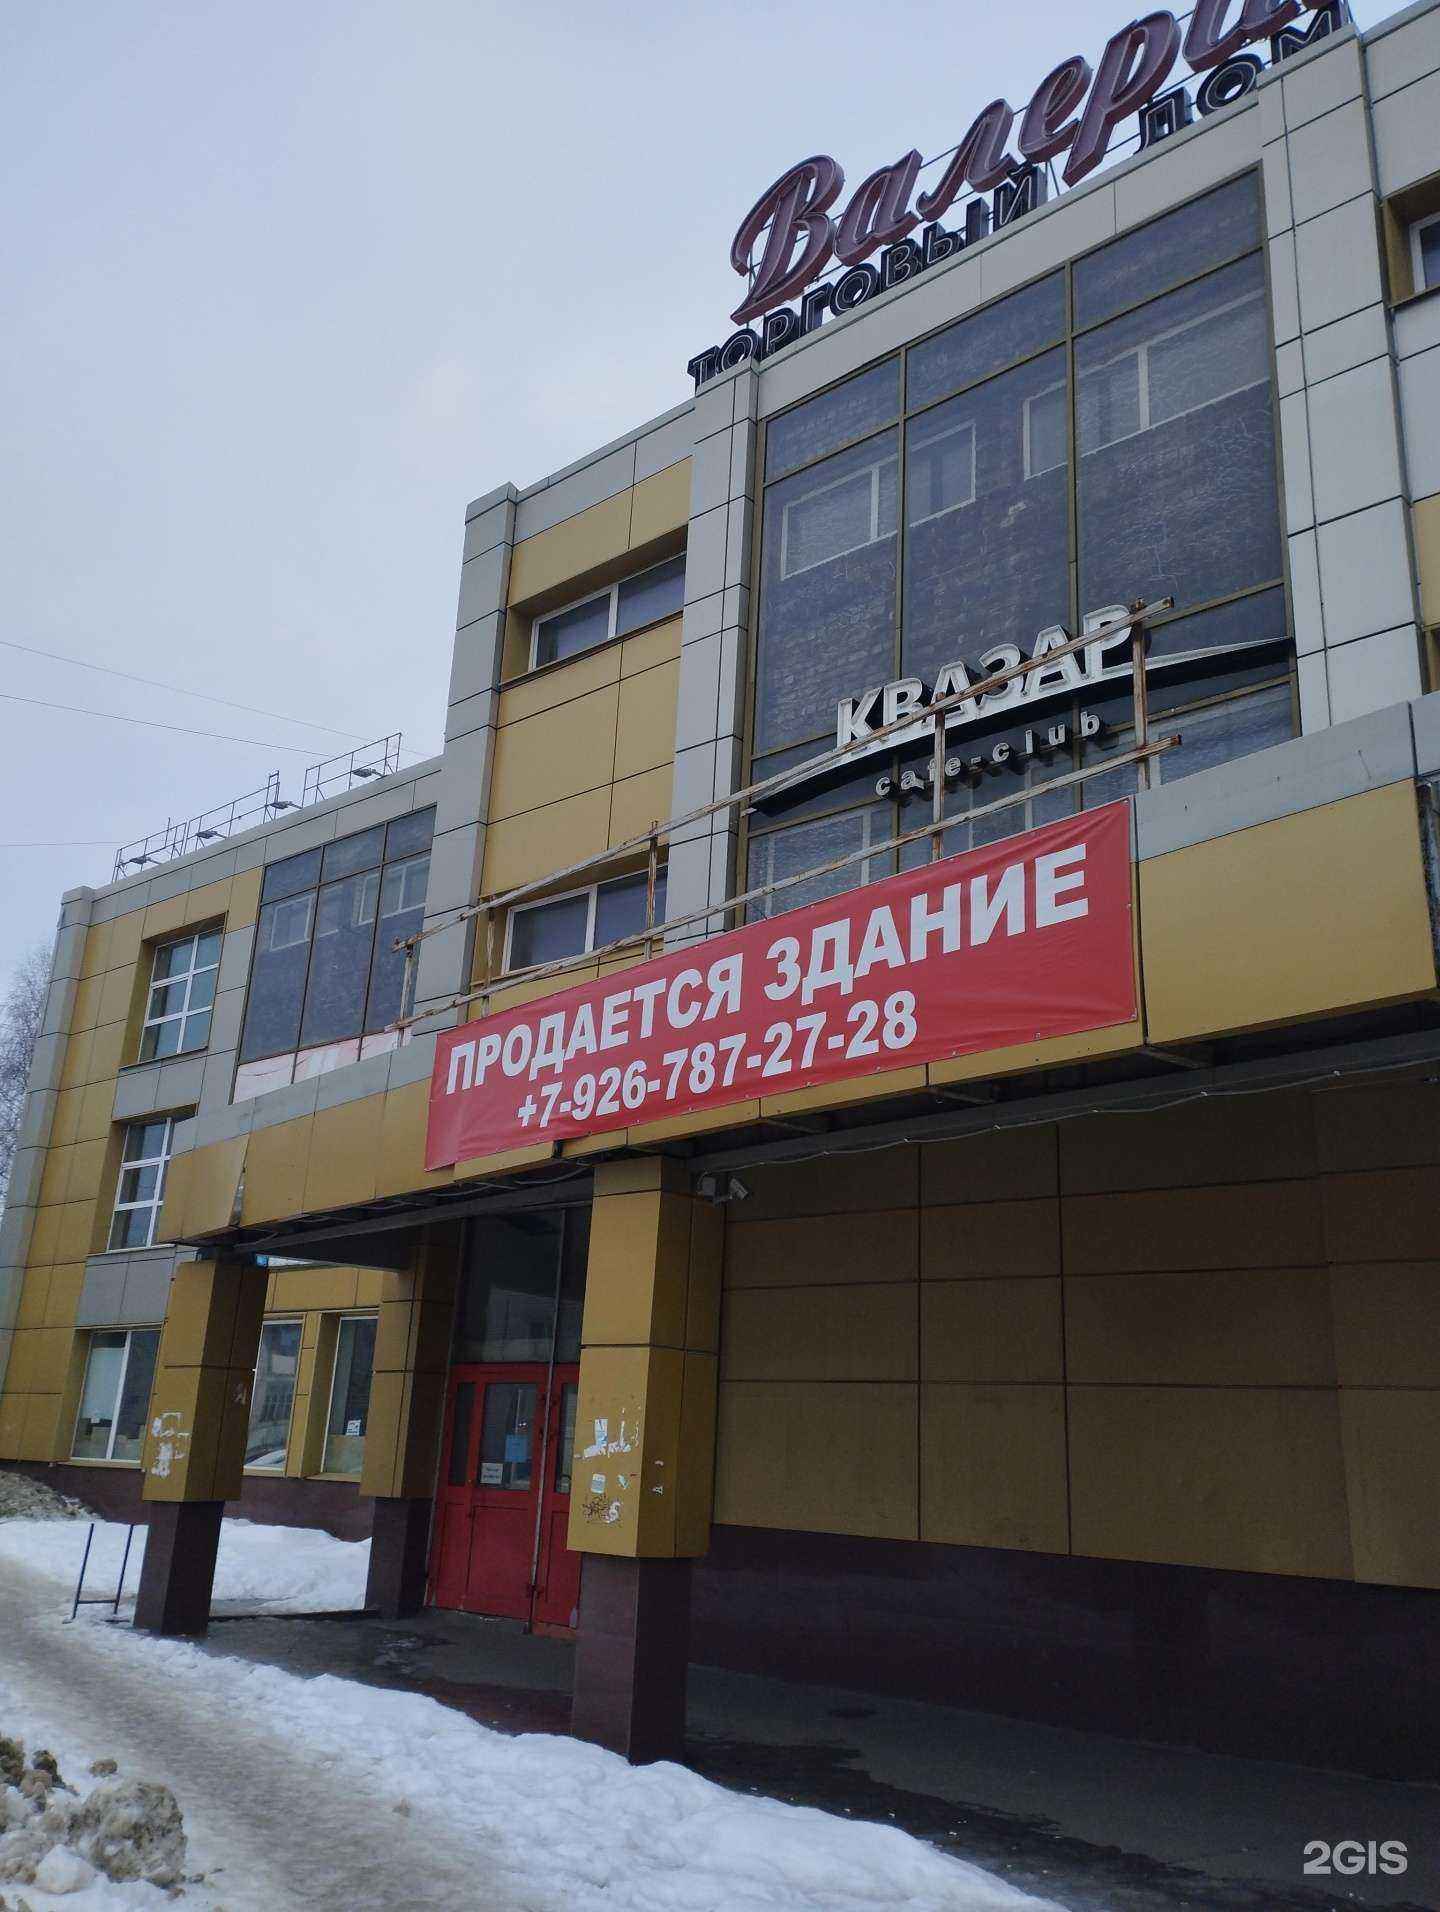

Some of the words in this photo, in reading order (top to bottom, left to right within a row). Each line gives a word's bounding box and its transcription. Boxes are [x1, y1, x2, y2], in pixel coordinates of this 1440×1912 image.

[687, 161, 1048, 398] ТОРГОВЫЙ
[730, 0, 1342, 326] Валери
[834, 603, 1135, 756] КВАЗАР
[446, 951, 744, 1096] ПРОДАЕТСЯ
[763, 842, 1090, 1006] ЗДАНИЕ
[516, 989, 919, 1129] +7-926-787-27-28
